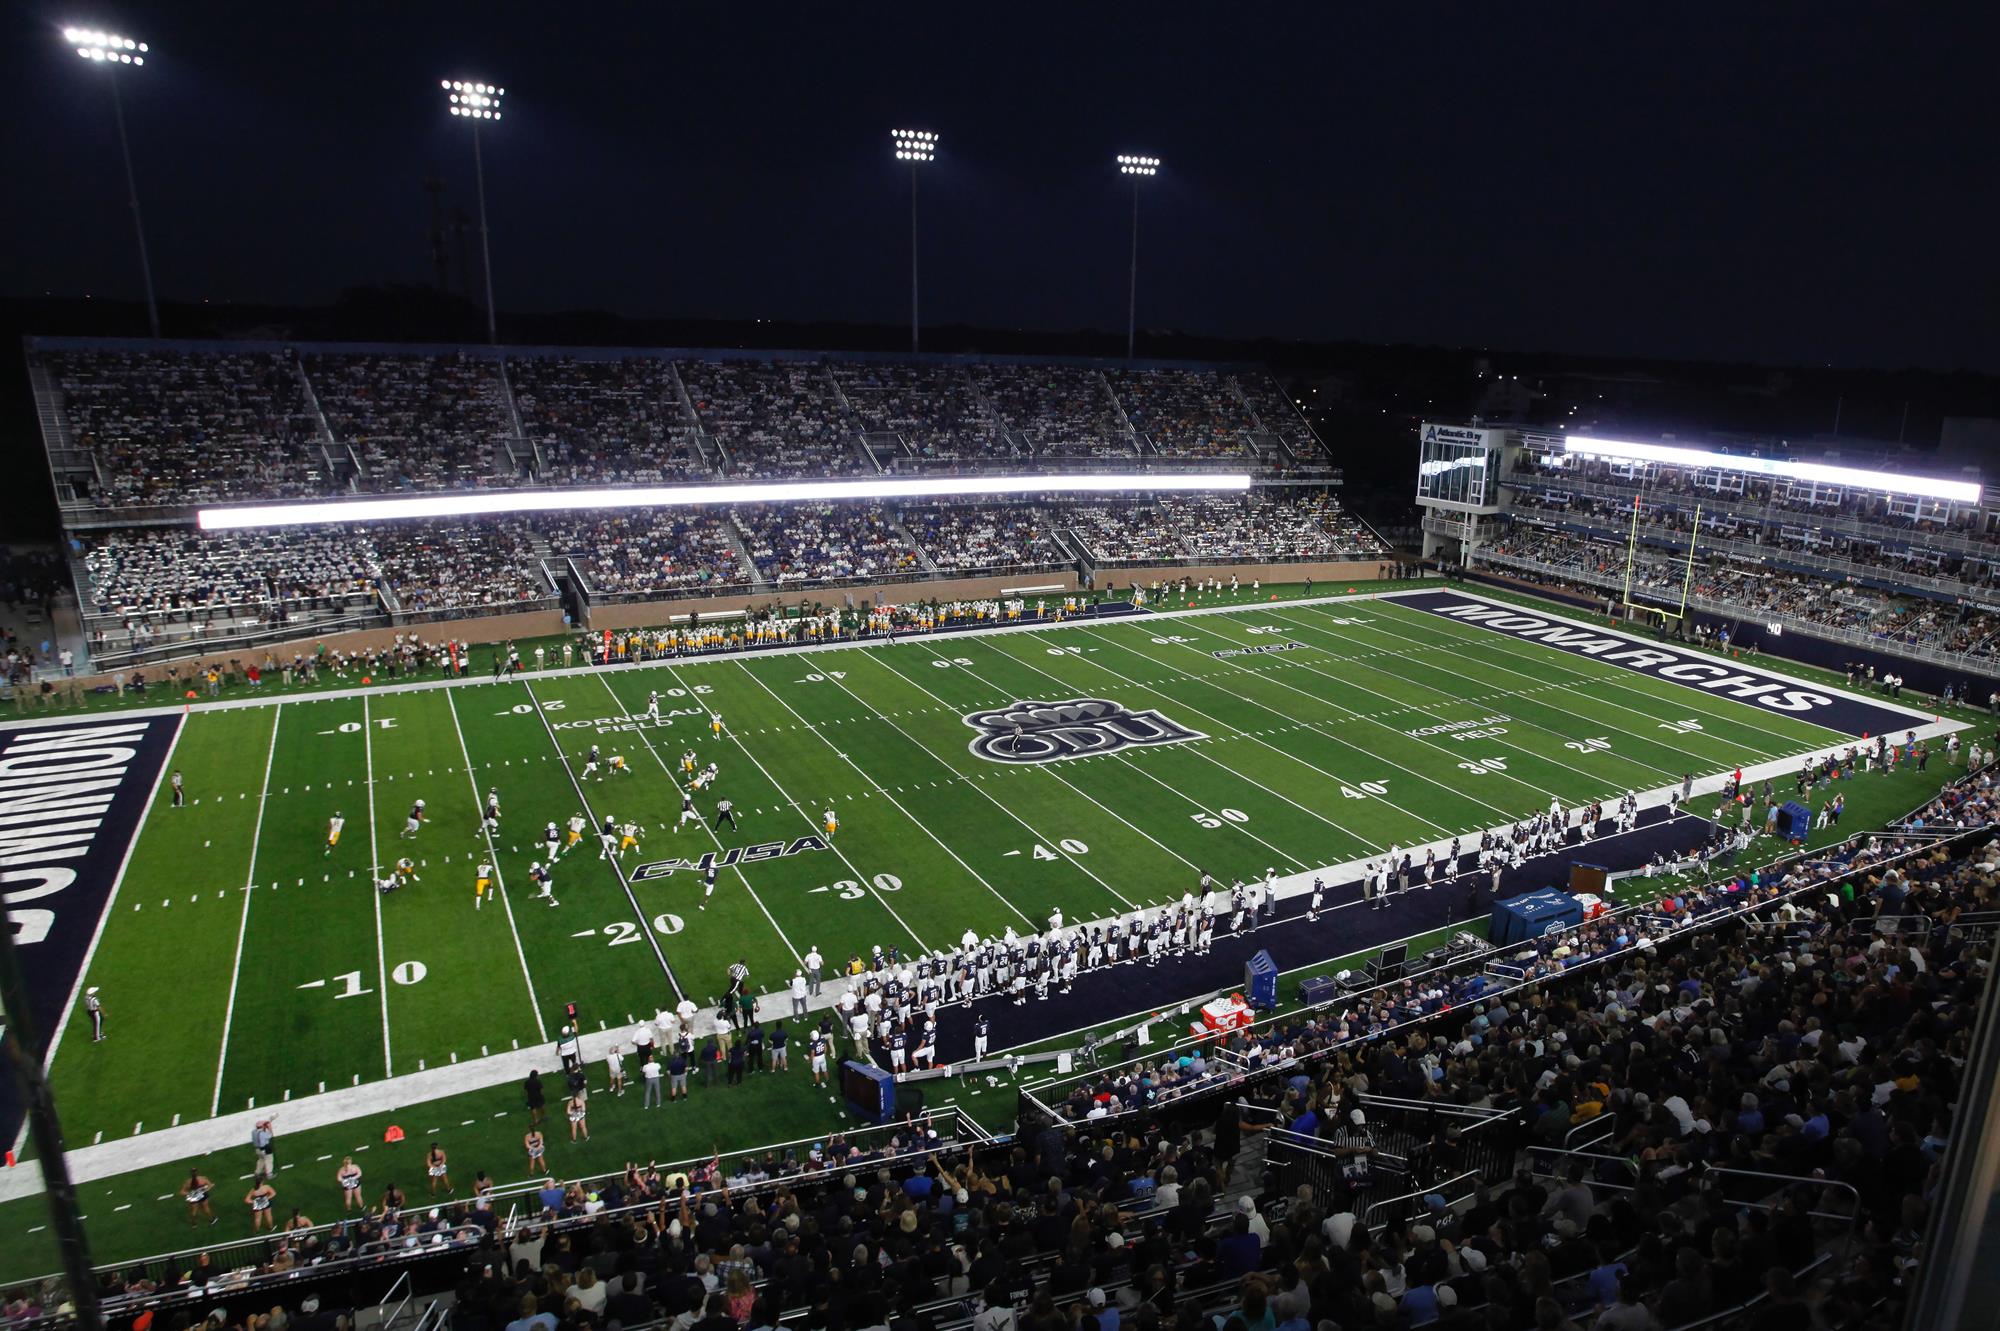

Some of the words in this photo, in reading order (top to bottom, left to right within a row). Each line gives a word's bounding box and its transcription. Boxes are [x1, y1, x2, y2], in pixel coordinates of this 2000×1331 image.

[1767, 622, 1783, 636] 40
[1433, 603, 1833, 712] MONARCHS
[666, 684, 714, 697] 30
[512, 700, 567, 714] 20
[339, 717, 398, 733] 10
[596, 718, 674, 734] FIELD
[1405, 714, 1512, 738] KORNBLAU
[1450, 726, 1508, 741] FIELD
[974, 707, 1192, 762] ODU
[1564, 738, 1612, 754] 20
[1457, 758, 1508, 775] 30
[1340, 781, 1389, 800] 40
[1190, 808, 1250, 829] 50
[1033, 838, 1090, 863] 40
[831, 873, 902, 900] 30
[603, 913, 685, 947] 20
[333, 961, 427, 999] 10
[1227, 1013, 1238, 1029] G
